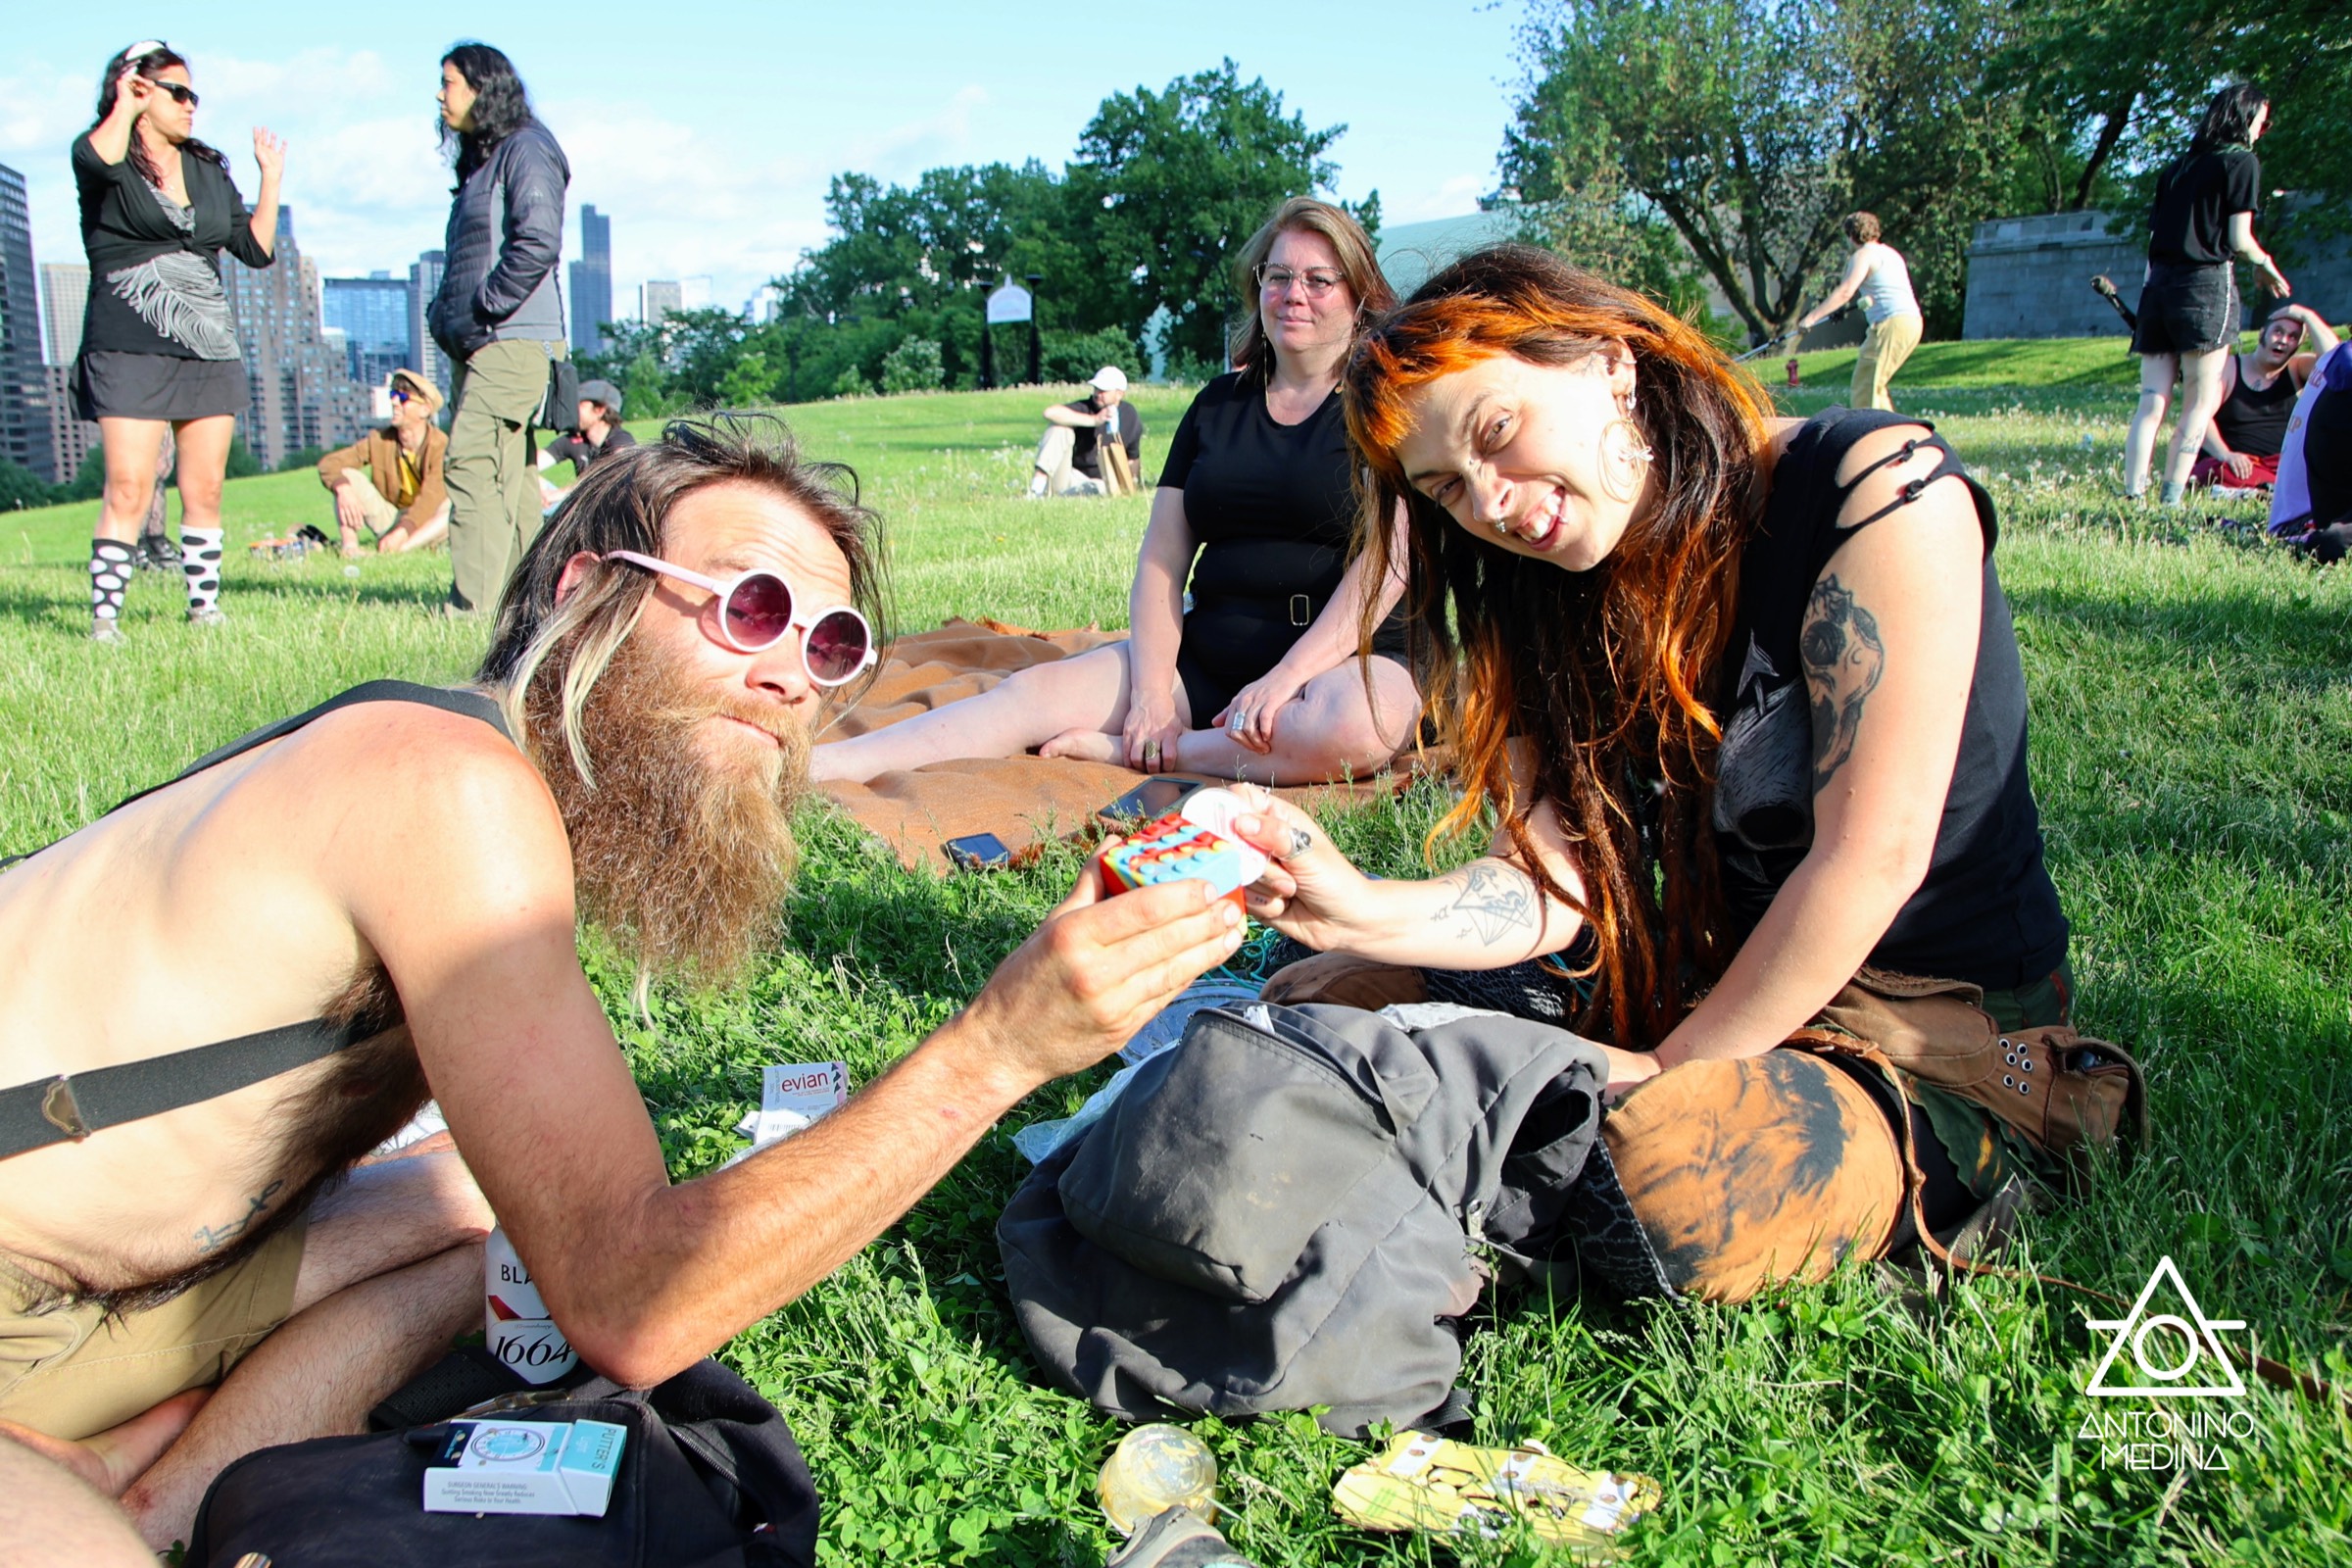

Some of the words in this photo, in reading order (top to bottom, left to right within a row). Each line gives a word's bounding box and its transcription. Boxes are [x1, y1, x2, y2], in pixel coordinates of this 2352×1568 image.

[781, 1072, 828, 1093] evian
[495, 1332, 574, 1366] 1664
[591, 1427, 617, 1470] PUTTER'S
